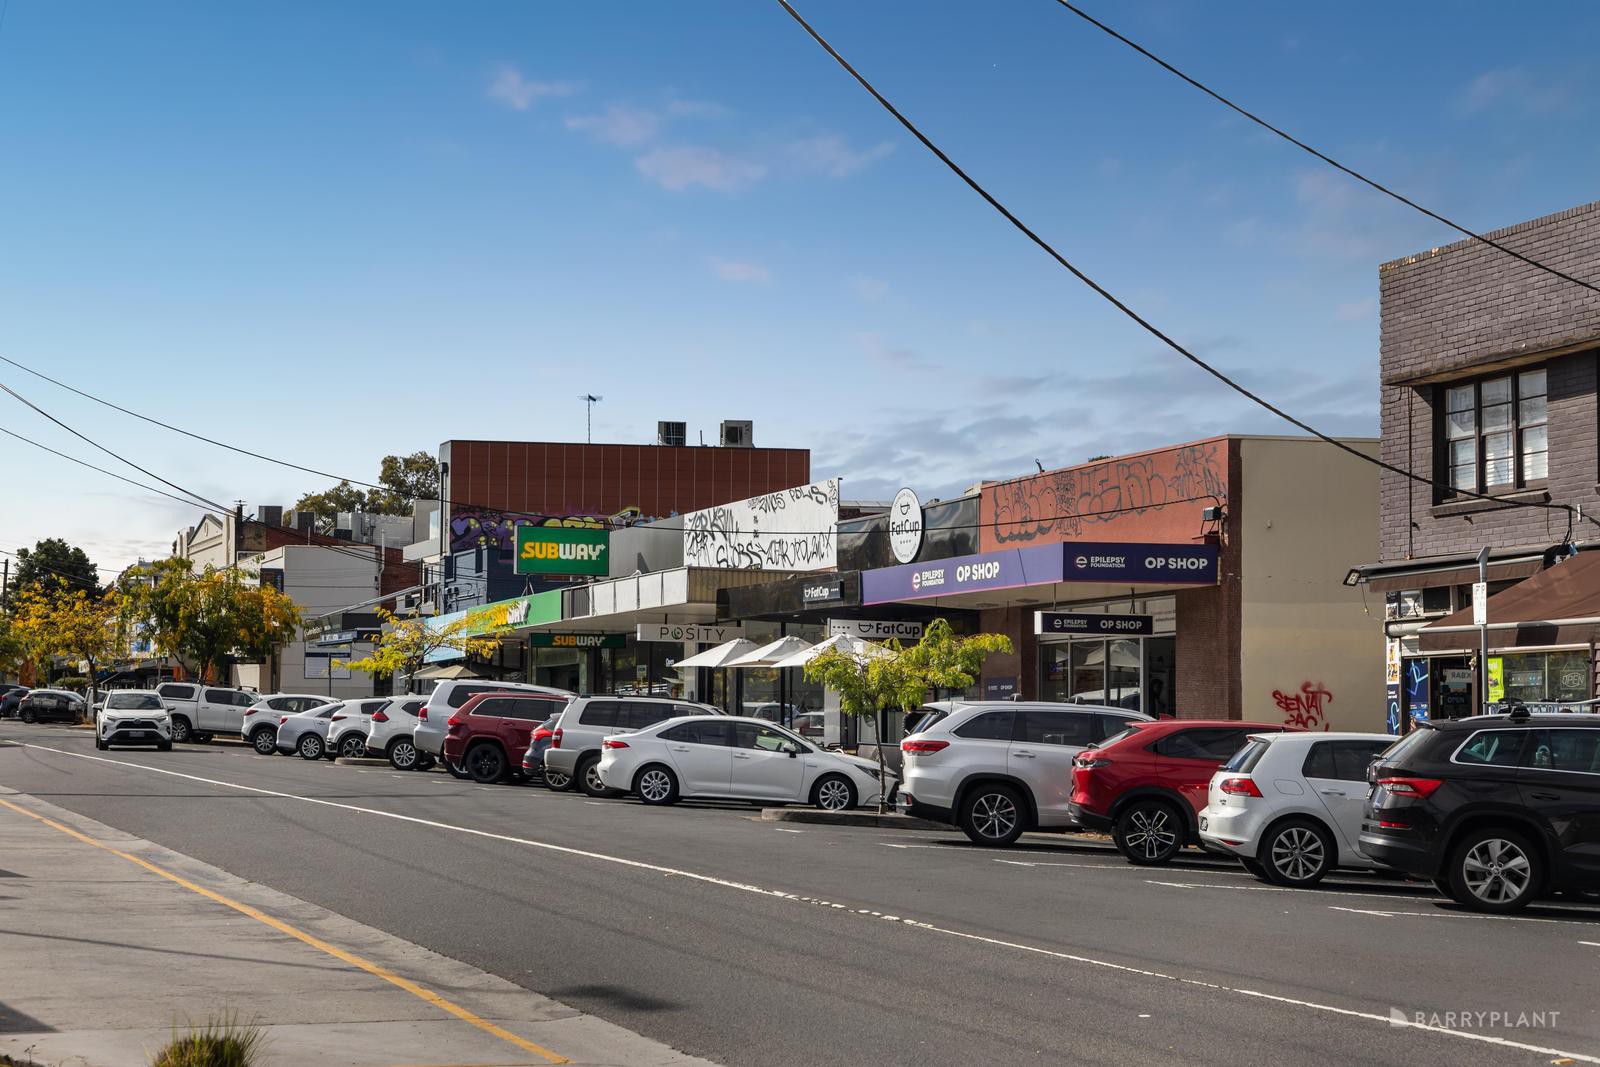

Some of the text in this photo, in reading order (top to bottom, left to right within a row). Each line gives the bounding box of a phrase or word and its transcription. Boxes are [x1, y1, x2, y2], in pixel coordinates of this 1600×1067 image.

[891, 519, 920, 537] FatCup
[520, 541, 606, 561] SUBWAY
[1090, 556, 1126, 564] EPILEPSY
[1145, 556, 1208, 570] OP SHOP
[922, 568, 945, 581] EPILEPSY
[956, 561, 1000, 583] OP SHOP
[811, 586, 829, 599] FatCup
[875, 623, 920, 637] FatCup
[1100, 619, 1143, 630] OP SHOP
[660, 626, 725, 641] POSITY
[552, 635, 606, 648] SUBWAY
